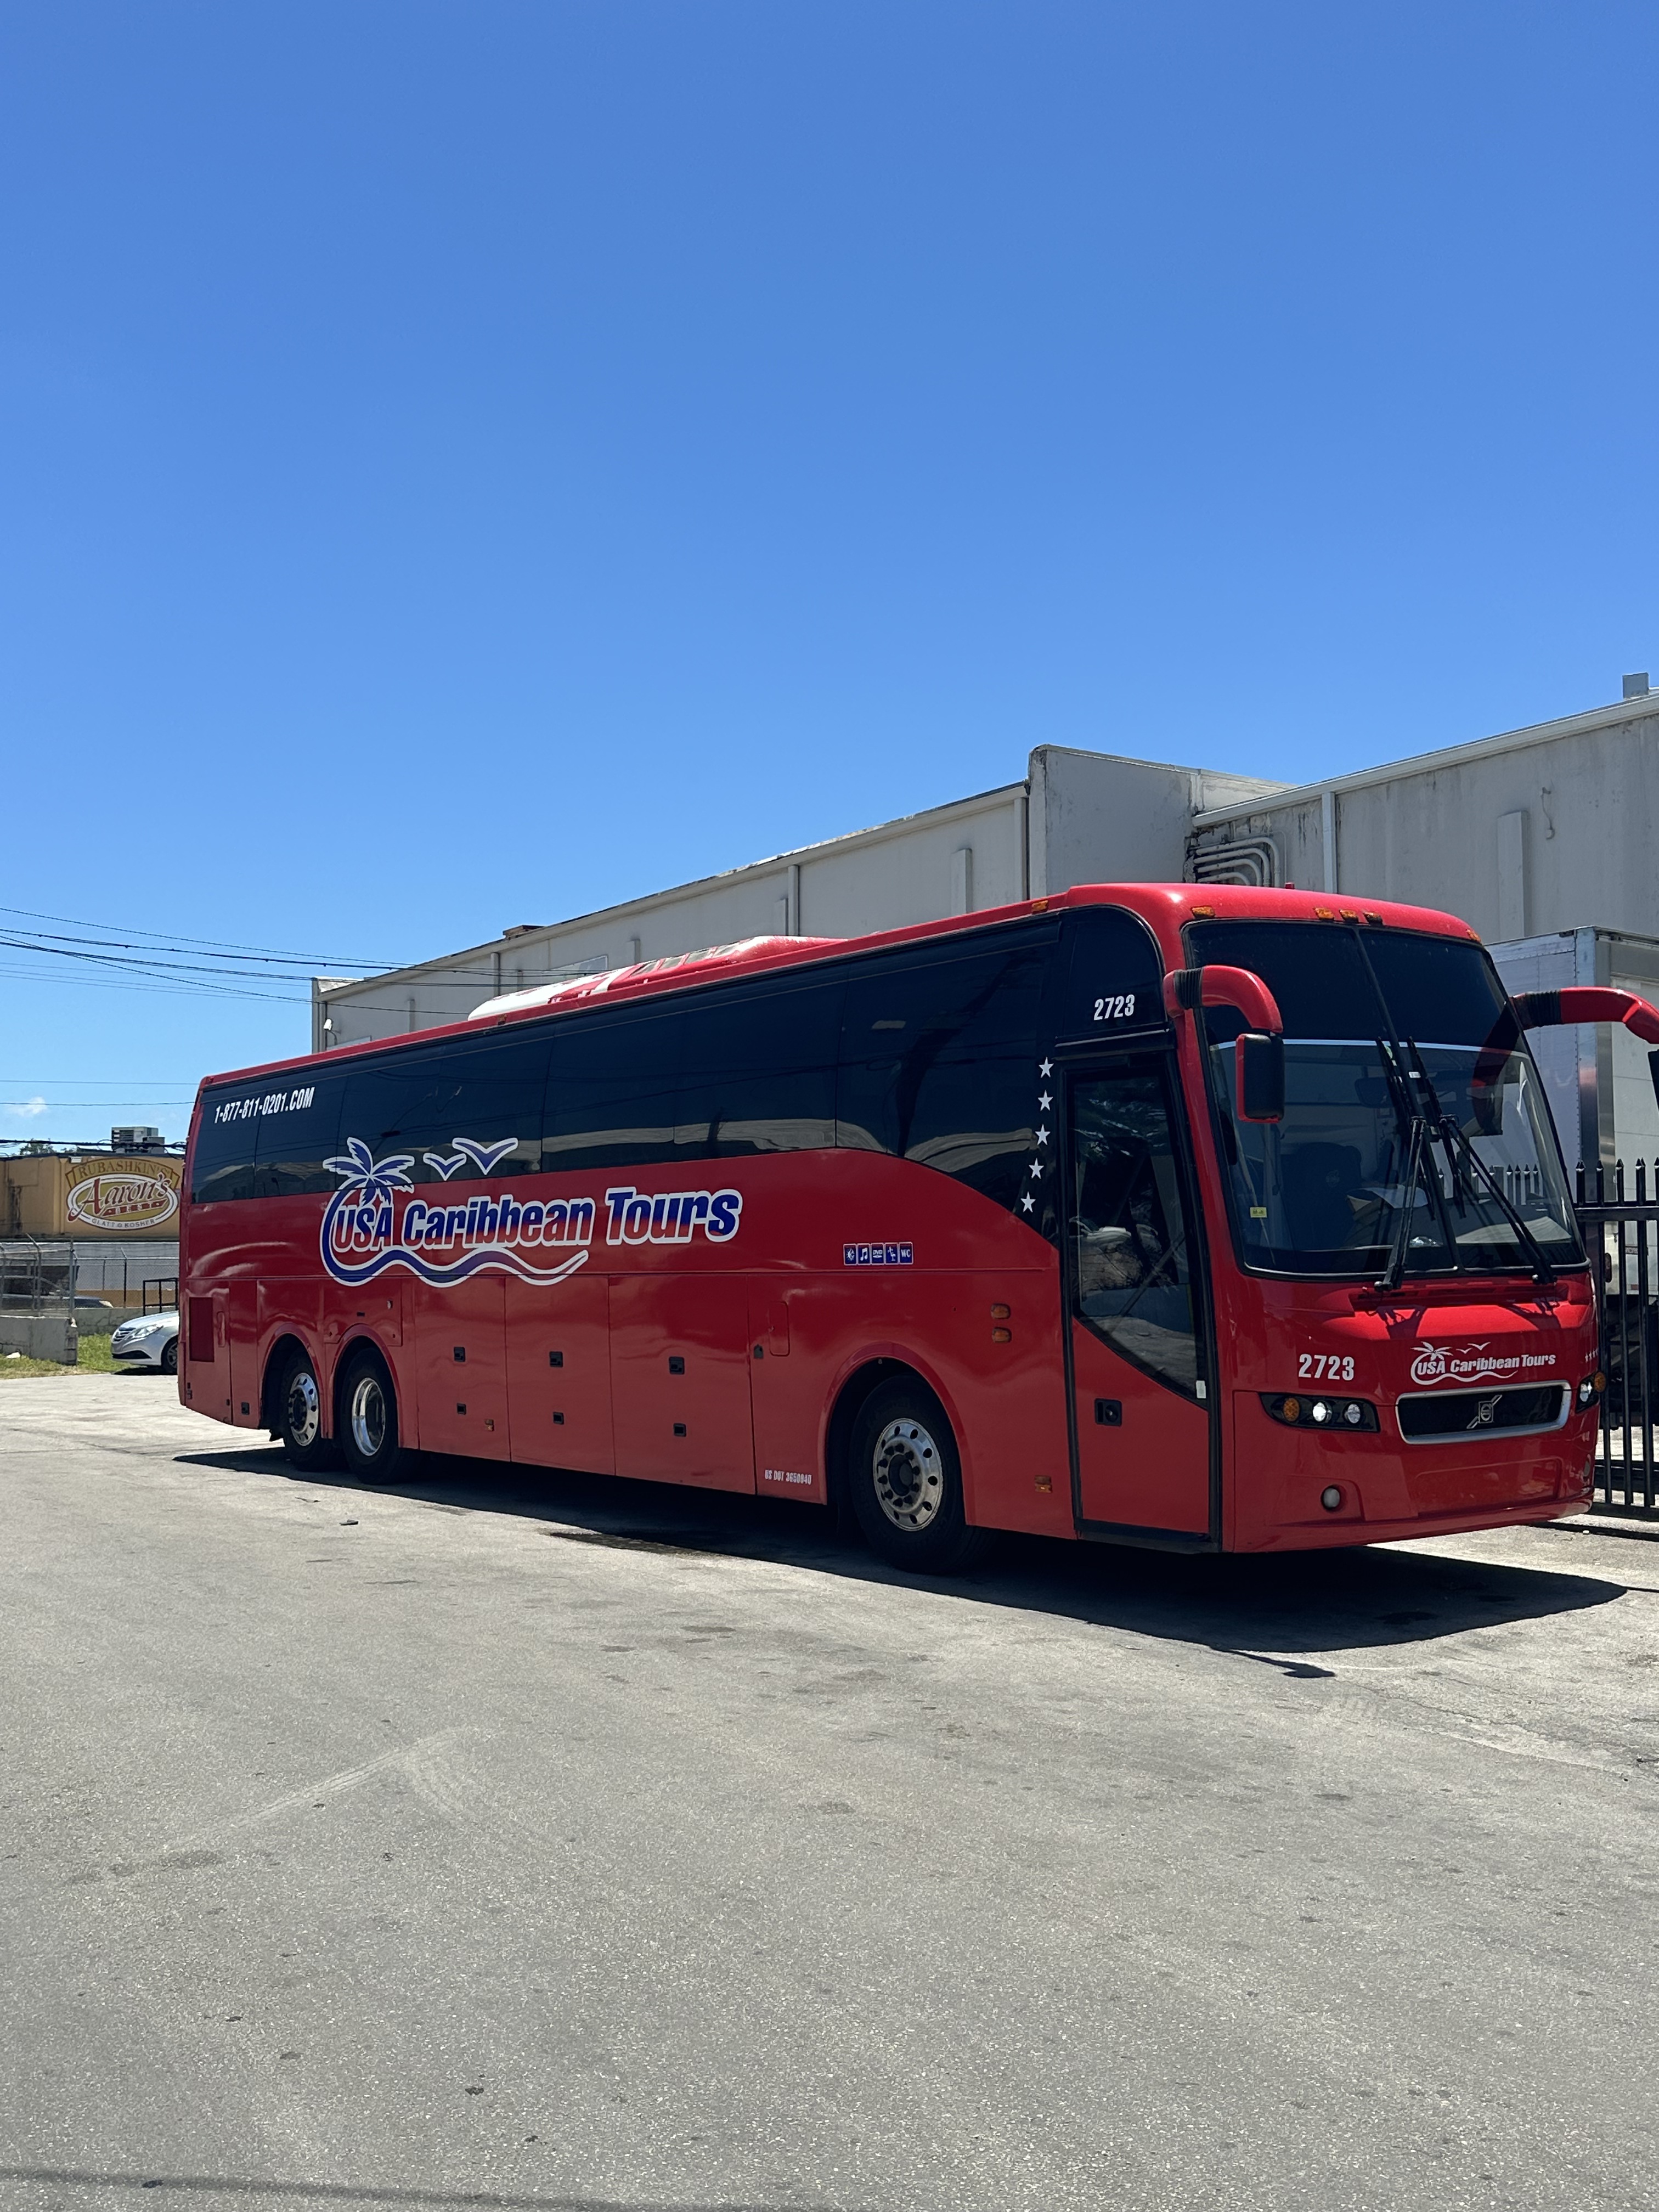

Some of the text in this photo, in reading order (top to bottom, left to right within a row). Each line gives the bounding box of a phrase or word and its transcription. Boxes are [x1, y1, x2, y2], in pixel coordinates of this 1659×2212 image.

[1093, 994, 1135, 1020] 2723
[215, 1087, 315, 1124] 1-877-811-0201.COM
[78, 1160, 168, 1179] RUBASHKIN'S
[68, 1172, 172, 1222] Aaron's
[92, 1218, 155, 1228] GLATT KOSHER
[332, 1186, 743, 1252] USA Caribbean Tours
[901, 1249, 911, 1258] WC
[1299, 1353, 1355, 1380] 2723
[1417, 1353, 1556, 1375] USA Caribbean Tours
[774, 1470, 785, 1481] DOT
